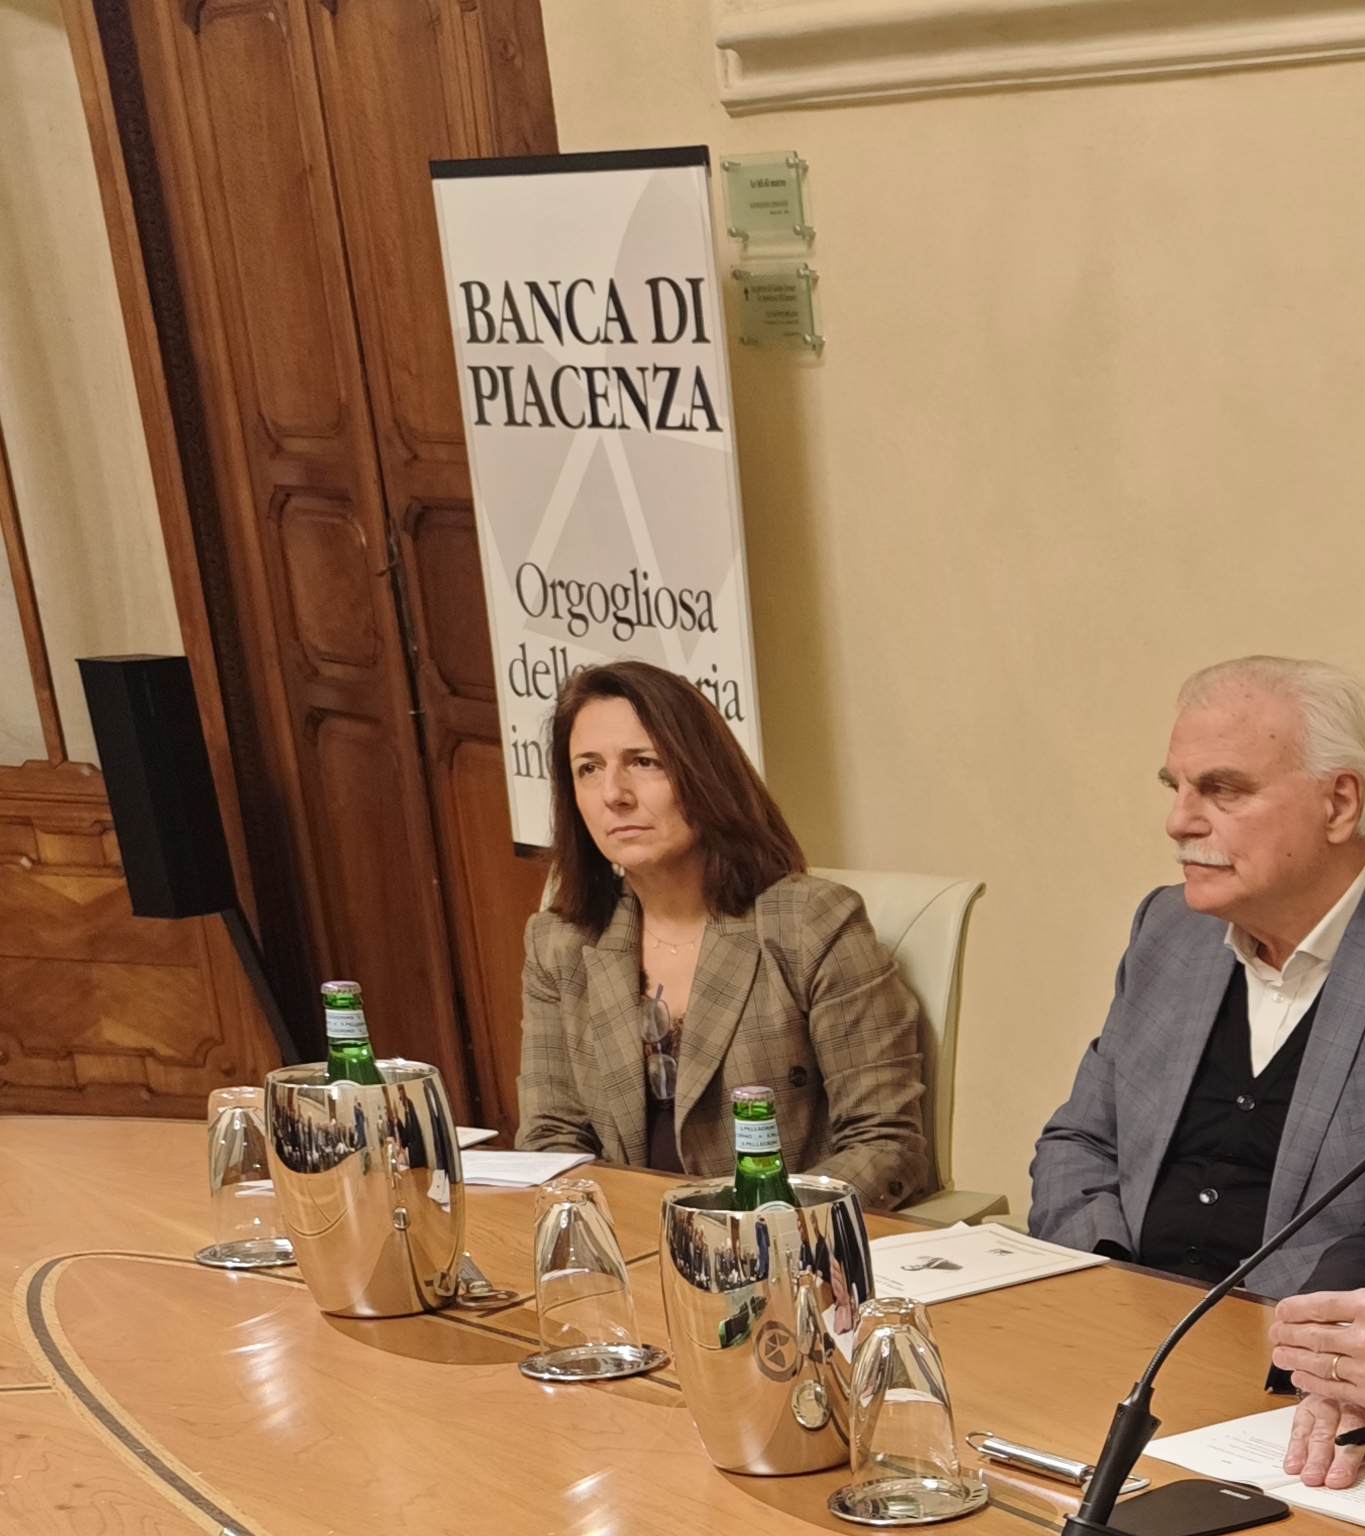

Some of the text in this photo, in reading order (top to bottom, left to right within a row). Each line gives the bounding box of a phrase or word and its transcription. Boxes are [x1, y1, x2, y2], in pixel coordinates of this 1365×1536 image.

[459, 276, 711, 346] BANCA DI
[467, 362, 724, 433] PIACENZA
[515, 562, 718, 642] Orgogliosa
